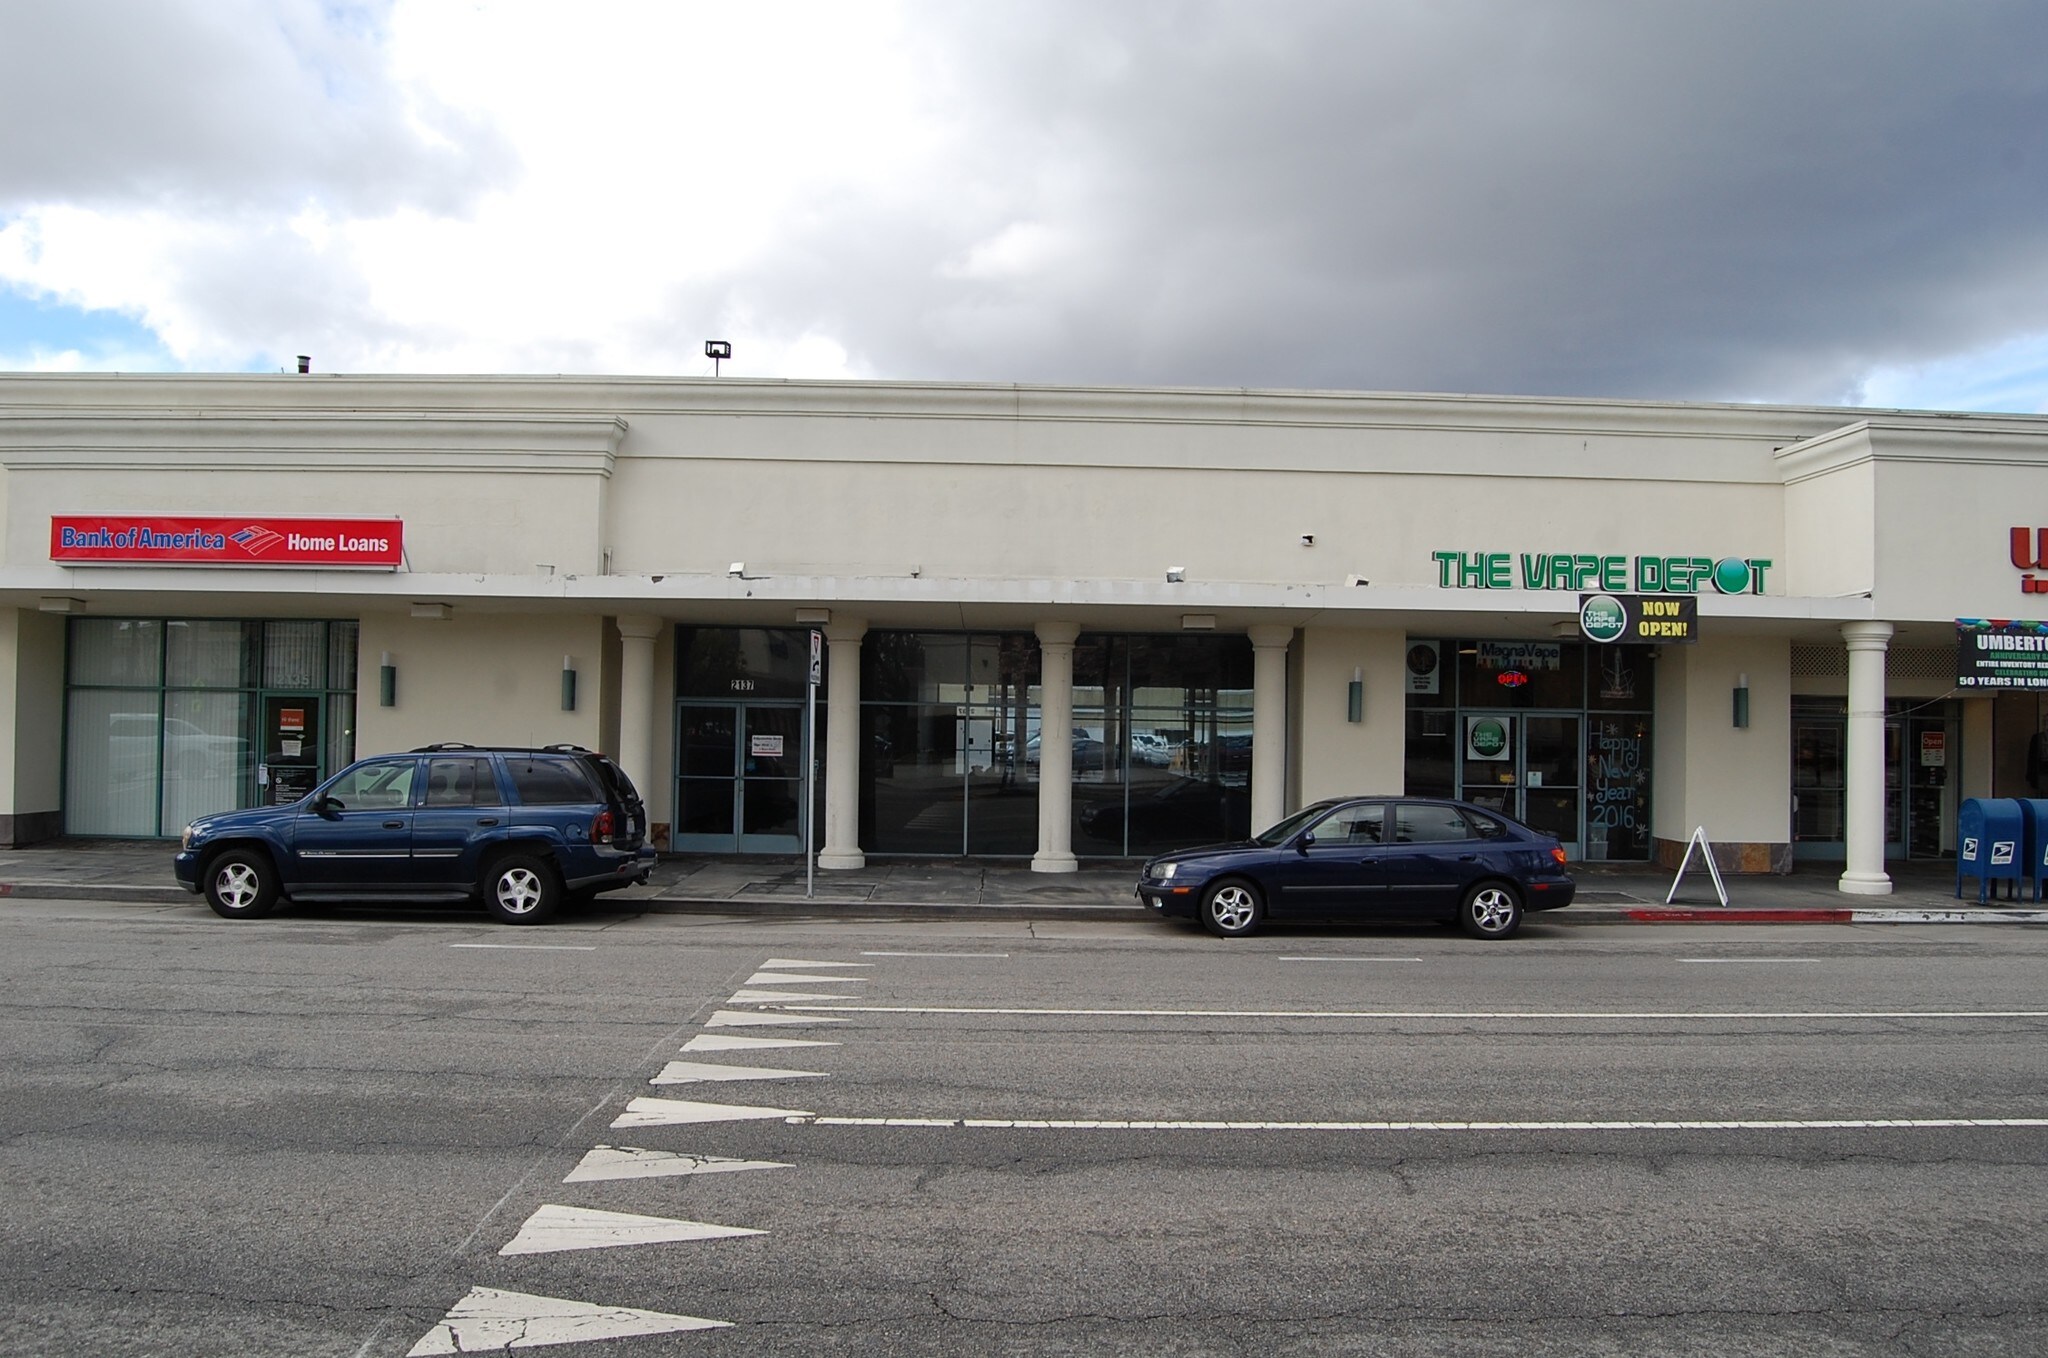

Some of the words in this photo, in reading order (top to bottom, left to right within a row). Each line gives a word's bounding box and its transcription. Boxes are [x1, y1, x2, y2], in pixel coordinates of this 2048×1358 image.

[61, 526, 113, 548] Bank
[115, 527, 137, 548] of
[138, 528, 226, 550] America
[288, 533, 335, 551] Home
[339, 534, 389, 552] Loans
[1432, 551, 1512, 590] THE
[1520, 553, 1627, 592] VAPE
[1635, 555, 1773, 596] DEPOT
[1642, 601, 1680, 616] NOW
[1638, 621, 1688, 637] OPEN!
[1481, 643, 1559, 660] MagnaVape
[1990, 652, 2040, 660] ANNIVERSARY
[2000, 661, 2036, 669] INVENTORY
[731, 680, 754, 690] 2137
[1498, 674, 1528, 684] OPEN
[1959, 677, 1975, 686] 50
[1978, 677, 2011, 686] YEARS
[2013, 678, 2025, 686] IN
[1589, 720, 1641, 769] Happy
[1923, 738, 1943, 746] Open
[1599, 754, 1632, 779] New
[1595, 778, 1636, 803] Year
[1592, 805, 1635, 828] 2016
